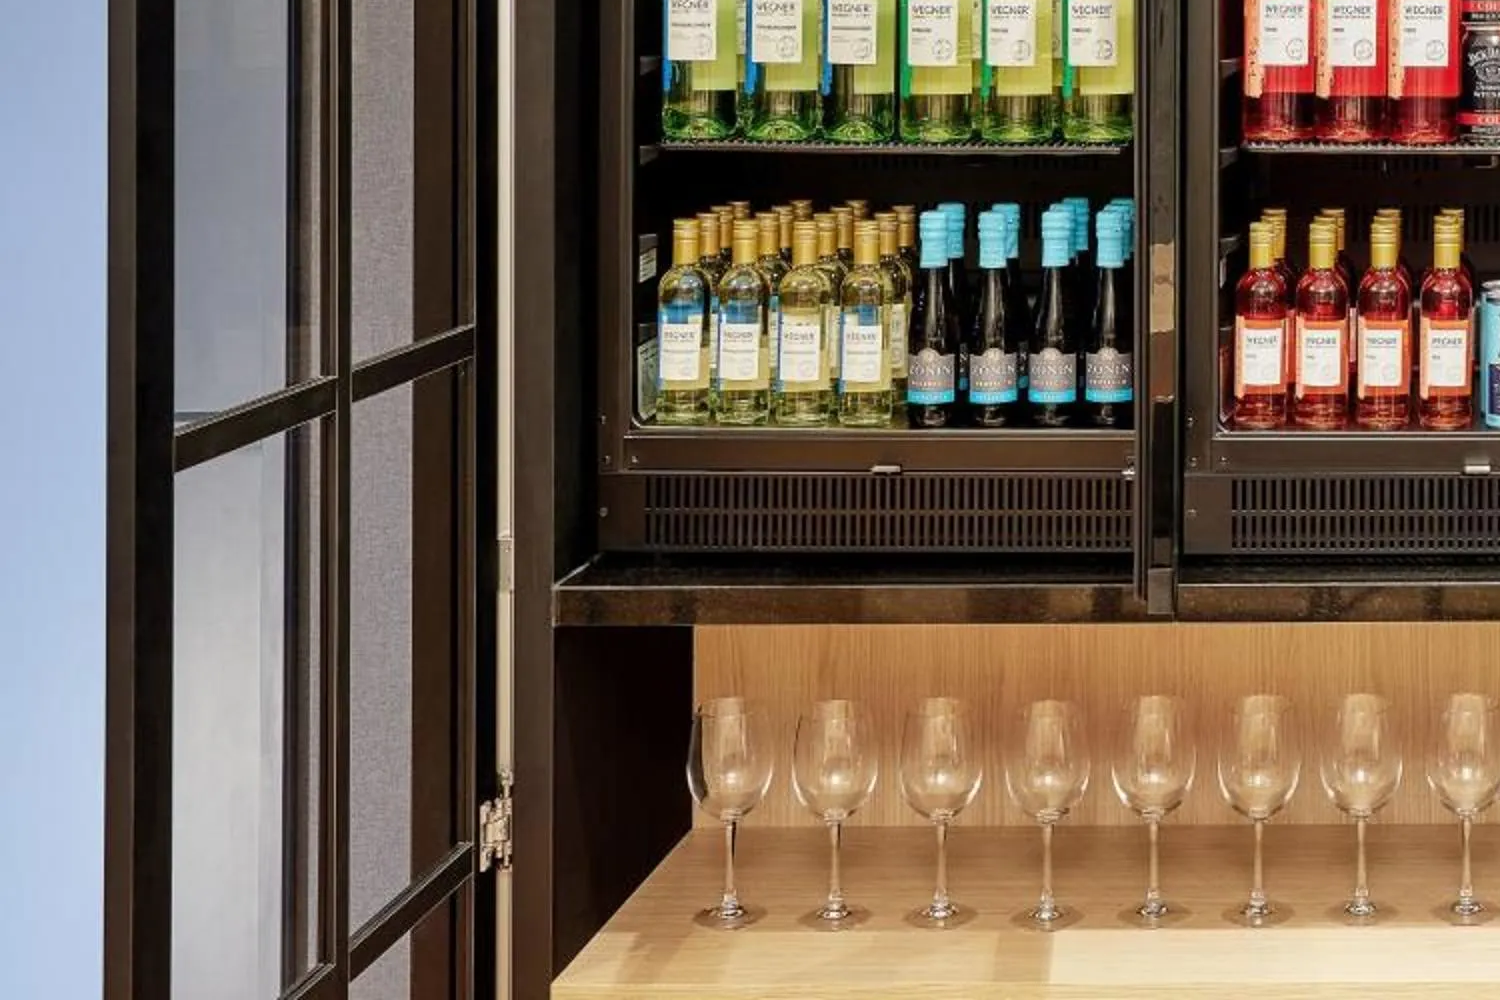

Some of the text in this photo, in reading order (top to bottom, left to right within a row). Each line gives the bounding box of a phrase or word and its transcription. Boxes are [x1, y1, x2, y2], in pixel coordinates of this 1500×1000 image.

[1265, 5, 1304, 14] WEGNER
[1333, 5, 1371, 15] WEGNER
[1405, 5, 1444, 15] WEGNER
